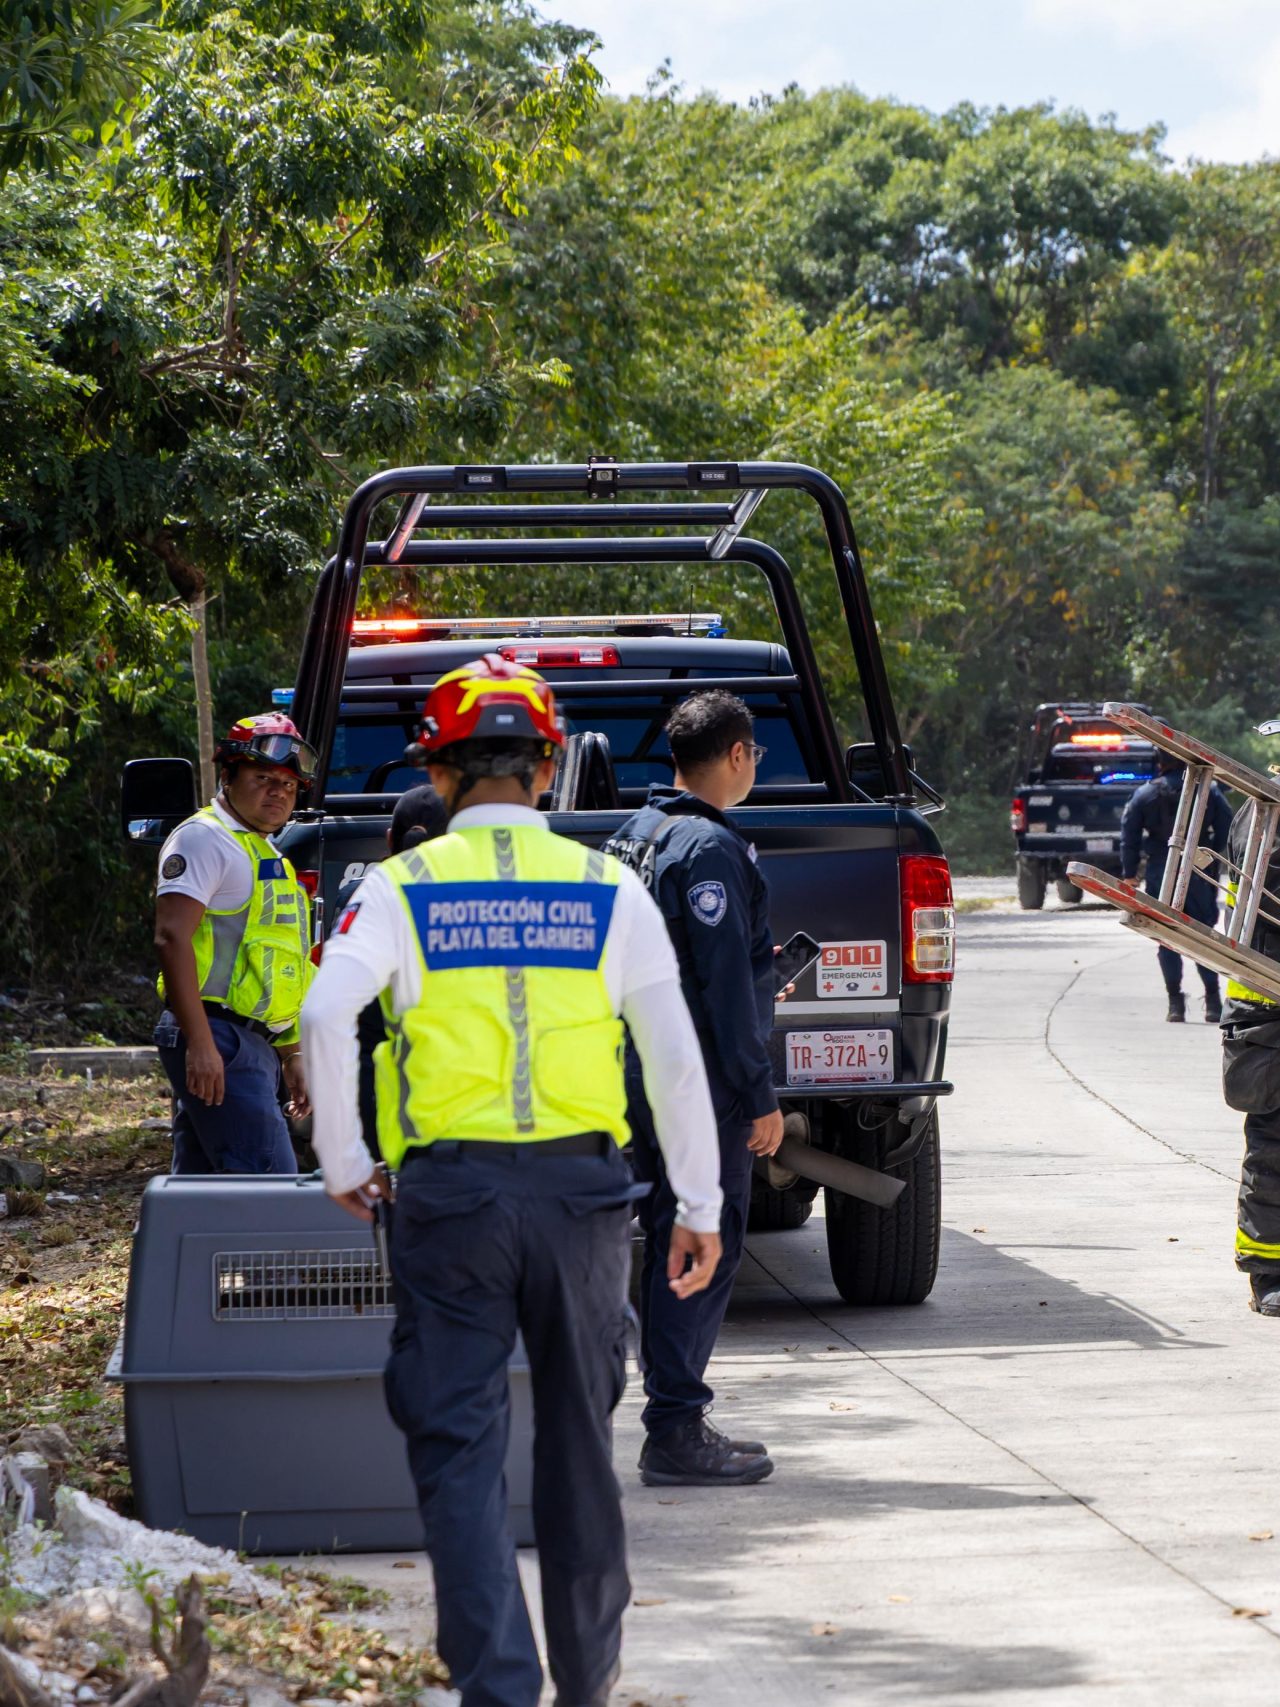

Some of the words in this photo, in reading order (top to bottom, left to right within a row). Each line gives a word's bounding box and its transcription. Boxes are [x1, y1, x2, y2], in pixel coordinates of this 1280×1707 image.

[428, 896, 545, 925] PROTECCIÓN
[548, 900, 596, 924] CIVIL
[427, 927, 485, 953] PLAYA
[486, 926, 520, 949] DEL
[523, 926, 596, 950] CARMEN
[825, 948, 876, 964] 911
[821, 971, 882, 980] EMERGENCIAS
[791, 1044, 888, 1069] TR-372A-9
